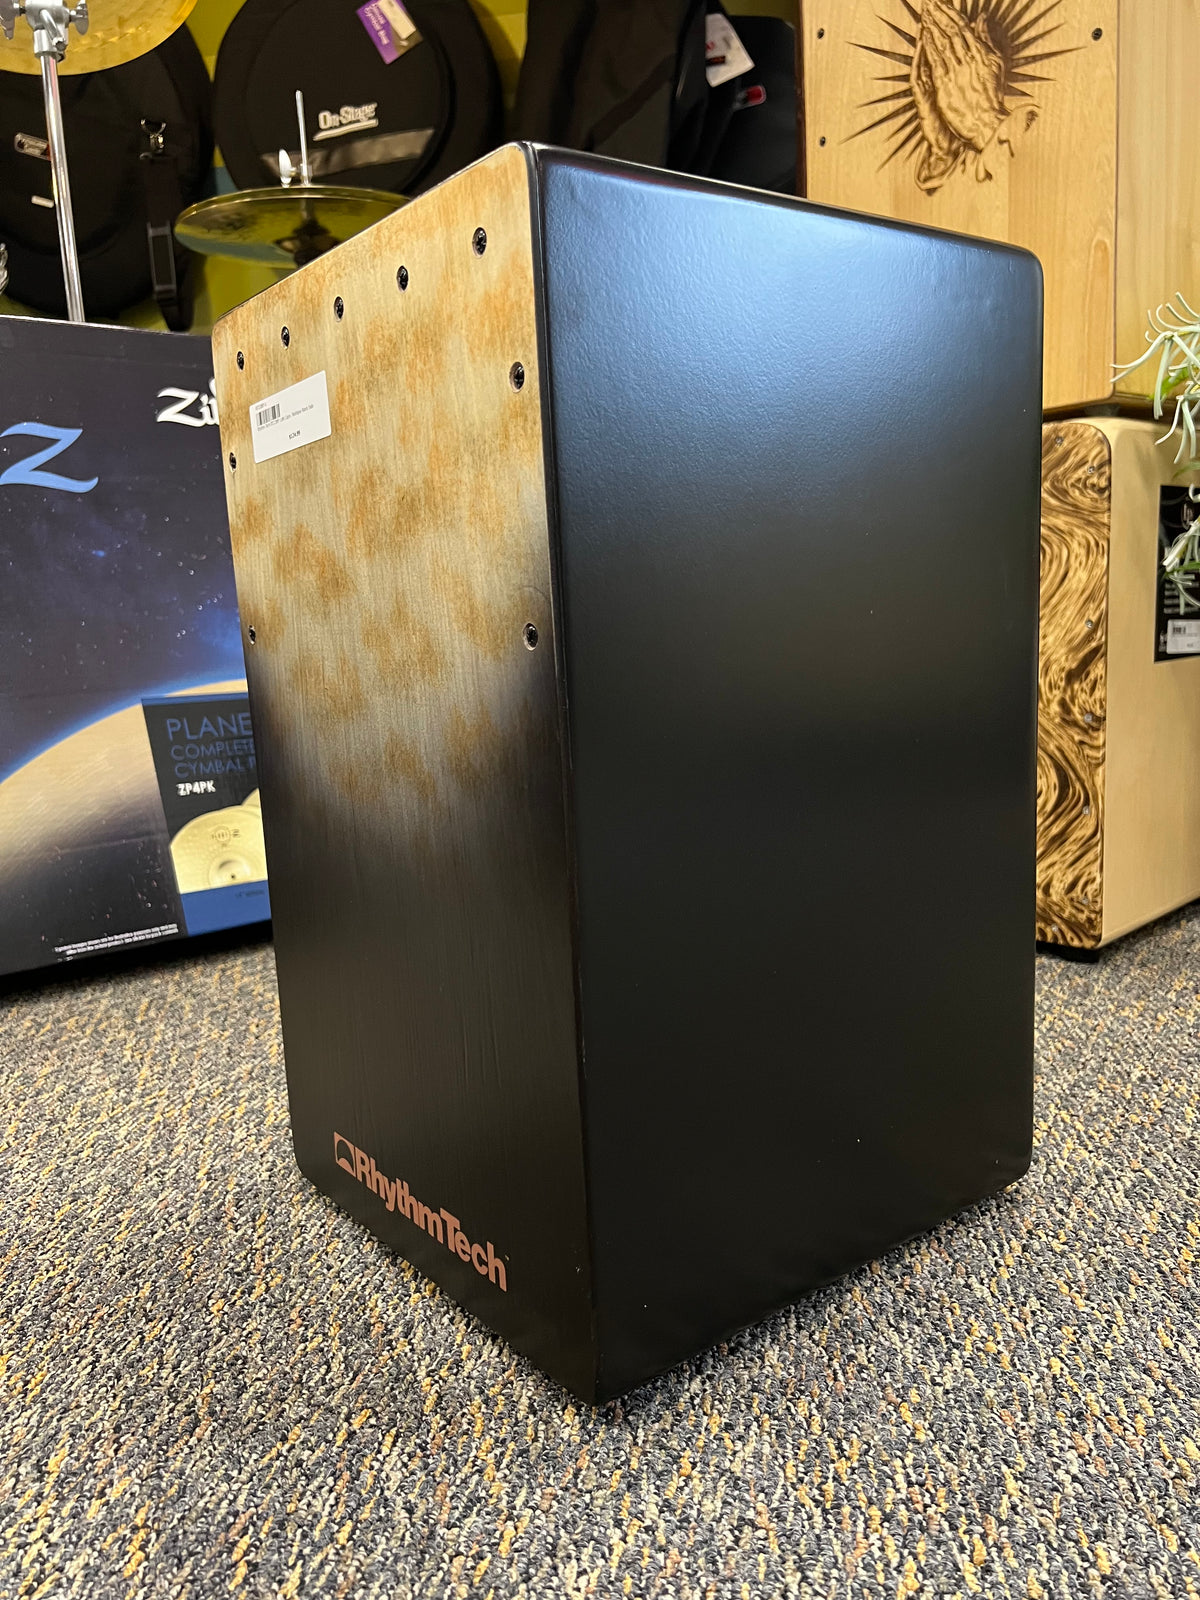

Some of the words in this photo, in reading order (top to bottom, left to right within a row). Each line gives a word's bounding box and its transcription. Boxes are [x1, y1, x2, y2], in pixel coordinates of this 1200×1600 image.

[174, 758, 245, 779] CYMBAL
[176, 779, 216, 796] ZP4PK
[354, 1146, 507, 1292] RhythmTech
